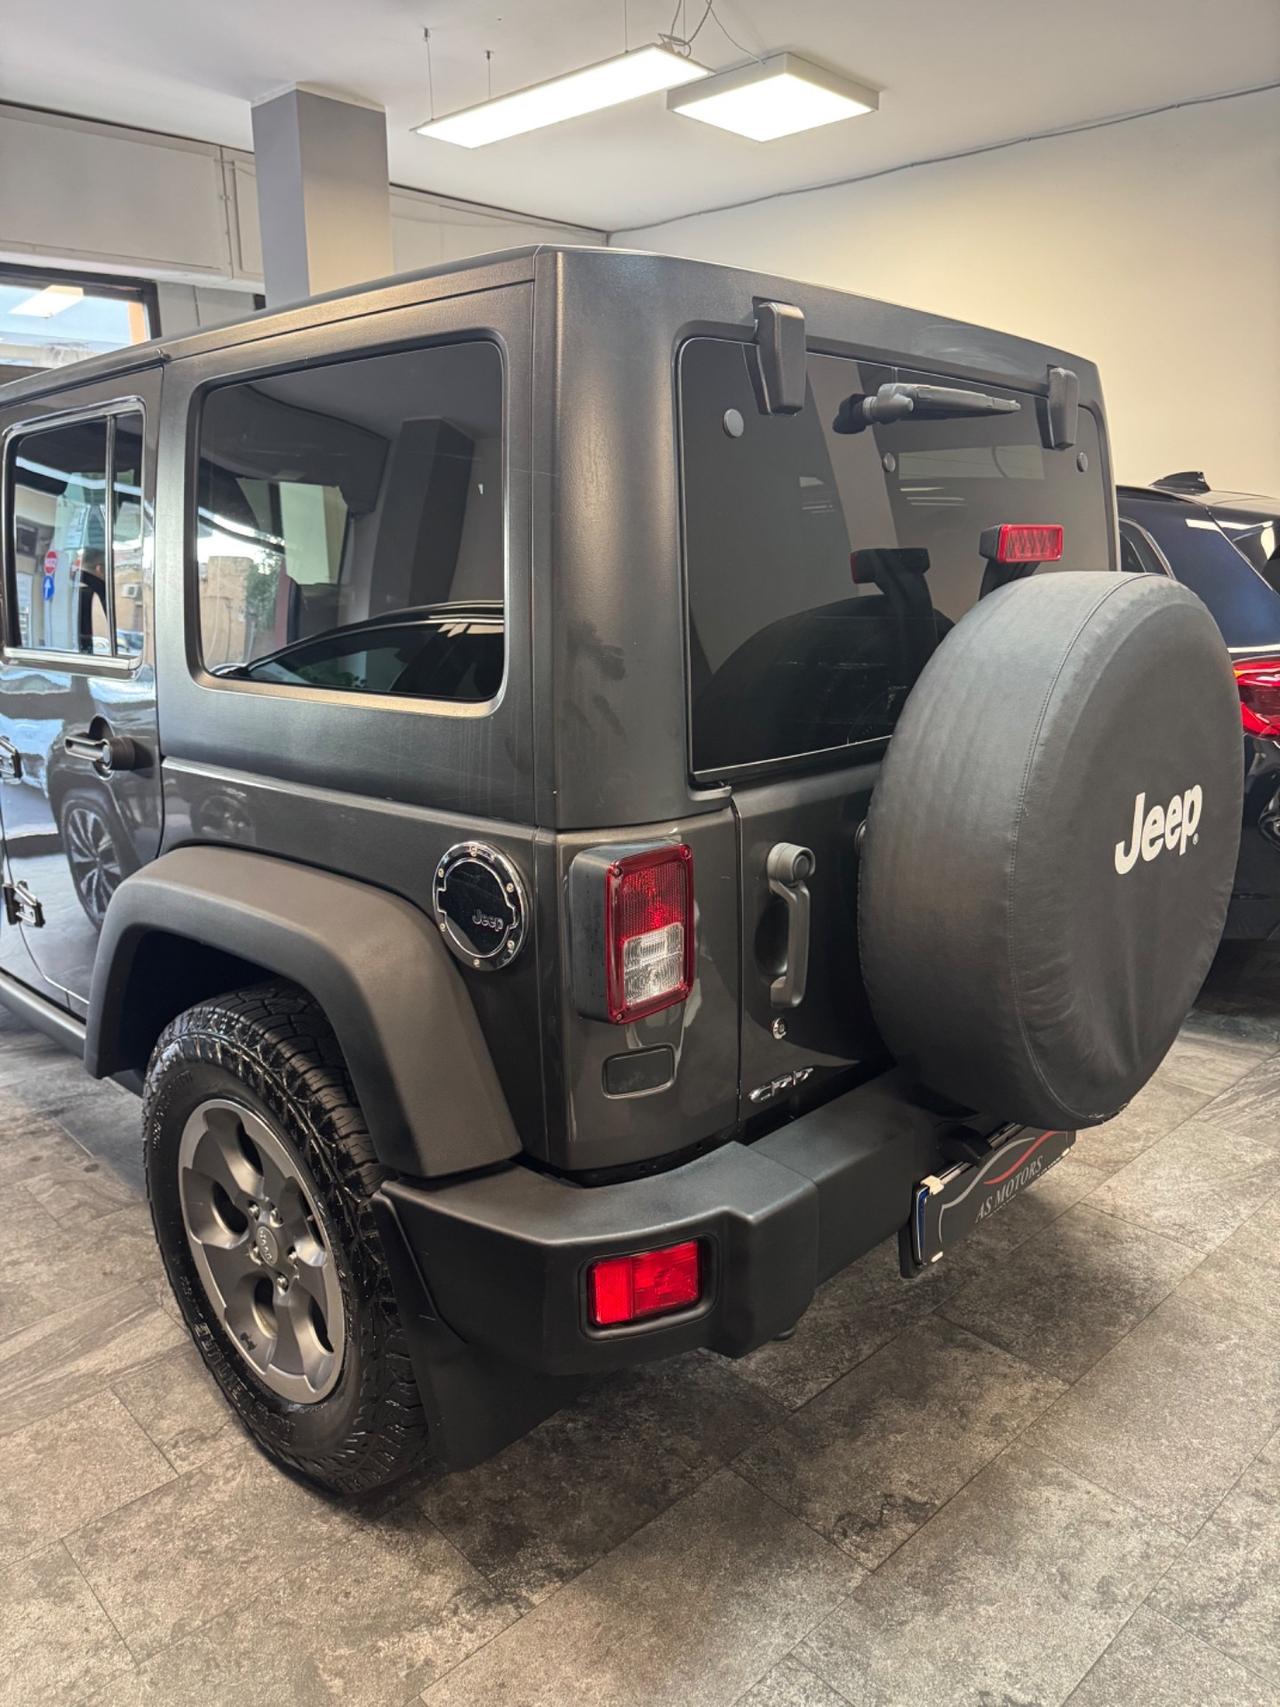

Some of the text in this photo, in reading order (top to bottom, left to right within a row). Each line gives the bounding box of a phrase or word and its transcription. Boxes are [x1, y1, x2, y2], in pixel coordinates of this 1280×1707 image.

[1115, 784, 1203, 875] Jeep
[472, 909, 504, 932] Jeep
[975, 1195, 993, 1224] AS
[994, 1155, 1044, 1208] MOTORS
